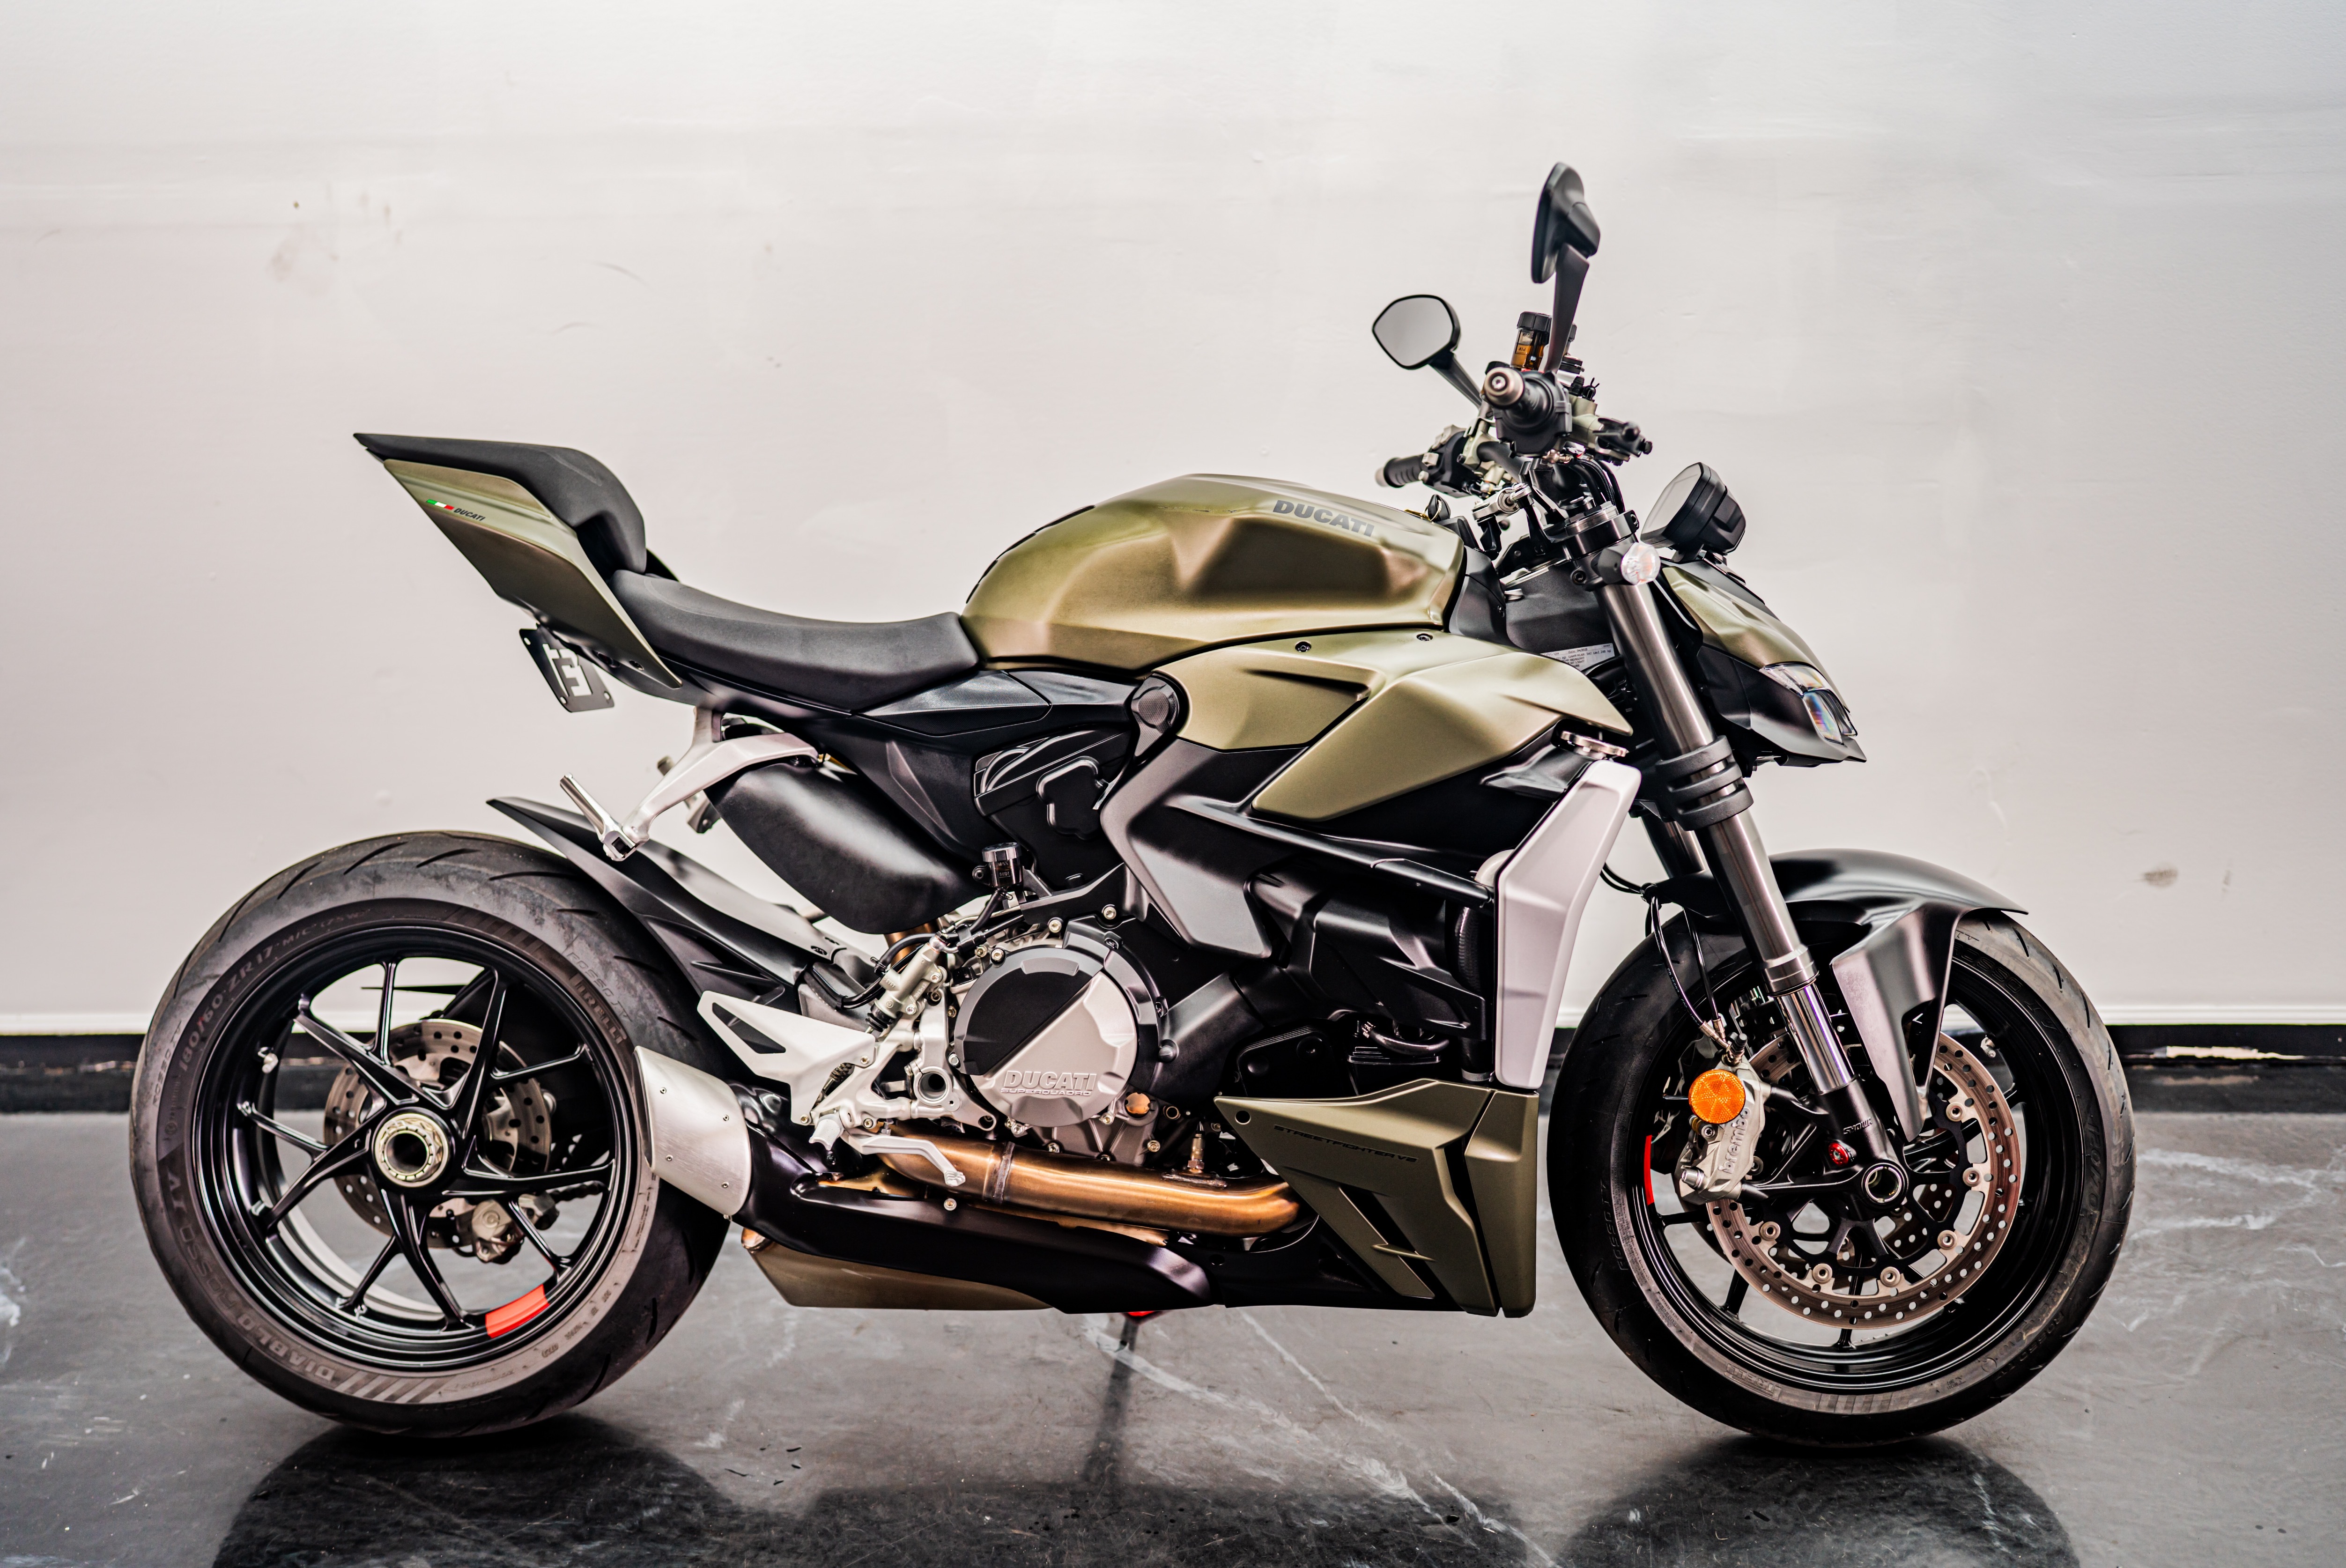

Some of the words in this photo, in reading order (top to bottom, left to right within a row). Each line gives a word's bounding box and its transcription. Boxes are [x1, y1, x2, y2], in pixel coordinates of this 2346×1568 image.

[453, 508, 486, 521] DUCATI
[1273, 500, 1375, 537] DUCATI
[566, 952, 613, 997] ROSSO
[569, 972, 627, 1044] PIRELLI
[1000, 1087, 1092, 1096] SUPERQUADRO
[1004, 1070, 1097, 1091] DUCATI
[1273, 1125, 1396, 1159] STREETFIGHTER
[1718, 1106, 1751, 1174] brembo
[1843, 1117, 1872, 1134] SHOWA
[181, 1226, 237, 1309] ROSSO
[1655, 1299, 1678, 1327] TUBELESS
[237, 1315, 335, 1382] DIABLO
[2020, 1316, 2061, 1361] ROSSO
[1724, 1363, 1783, 1400] PIRELLI
